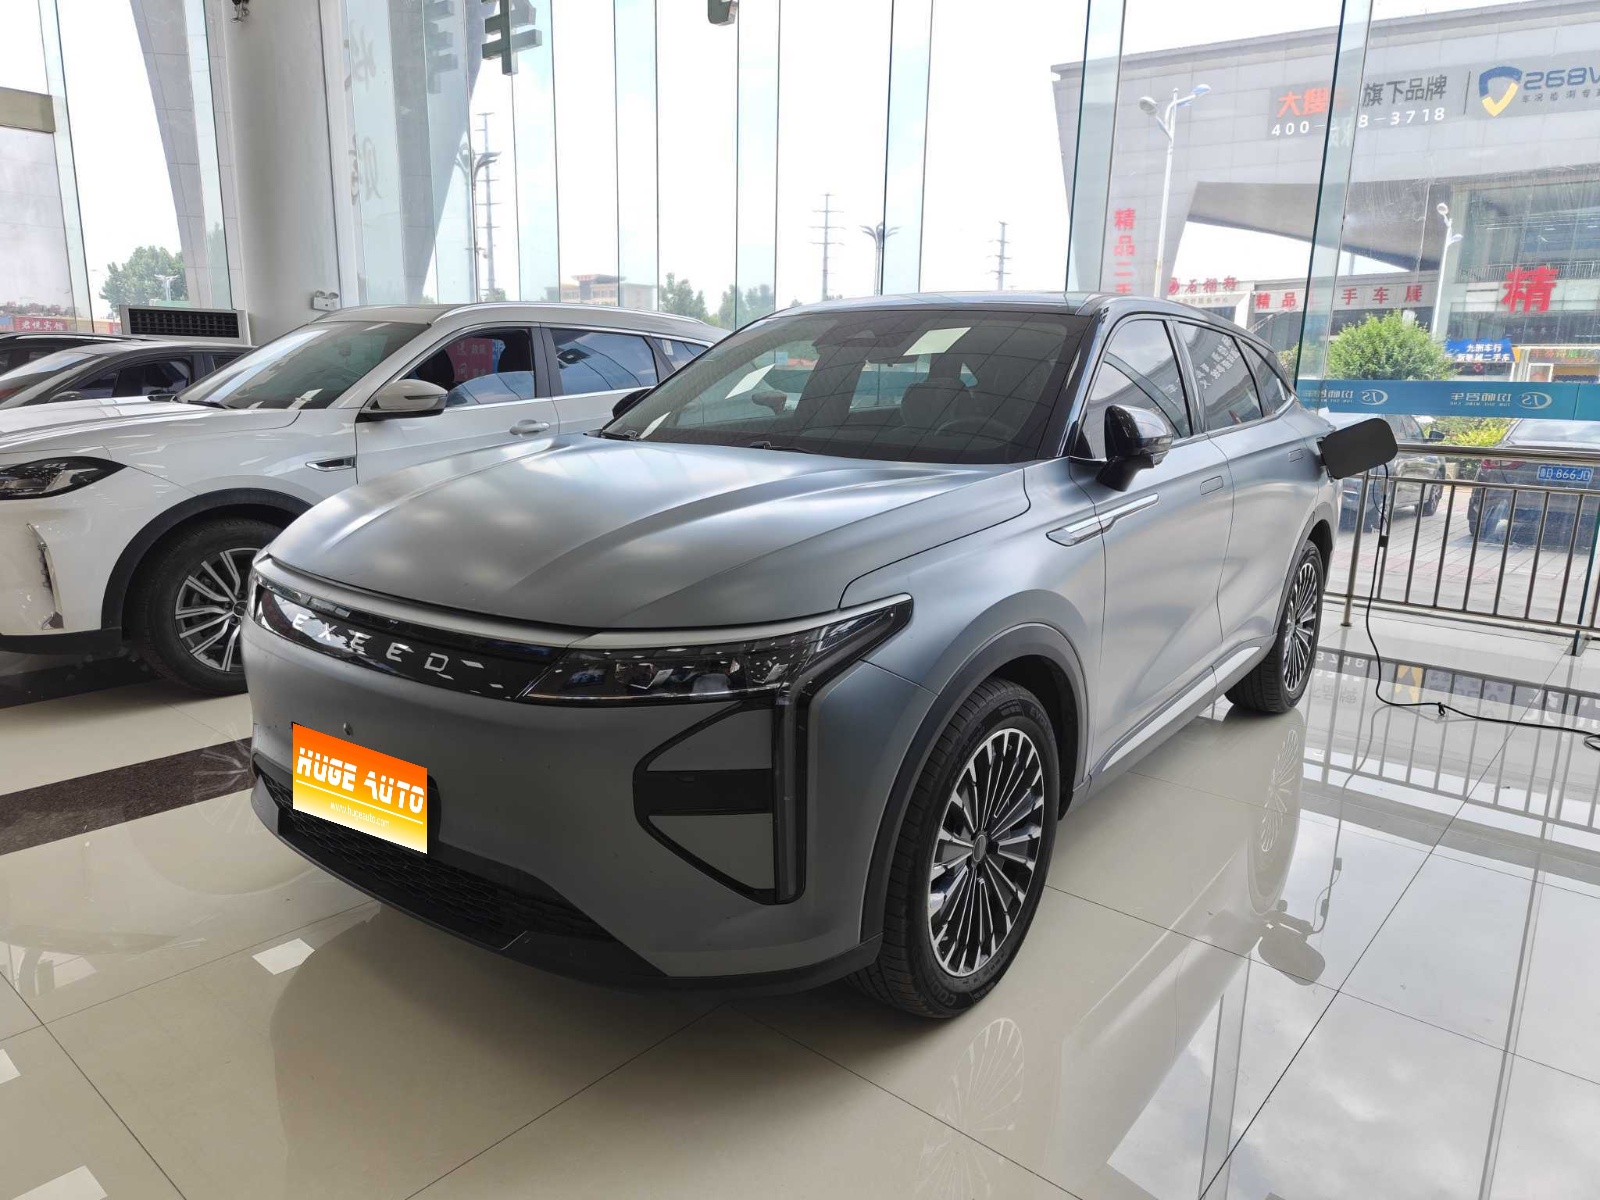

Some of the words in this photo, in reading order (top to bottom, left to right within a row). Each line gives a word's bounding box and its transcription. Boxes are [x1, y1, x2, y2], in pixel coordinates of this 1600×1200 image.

[1362, 74, 1448, 108] 旗下品牌
[1271, 107, 1445, 136] 400-8-3718
[1501, 265, 1560, 314] 精
[292, 613, 449, 673] EXEED
